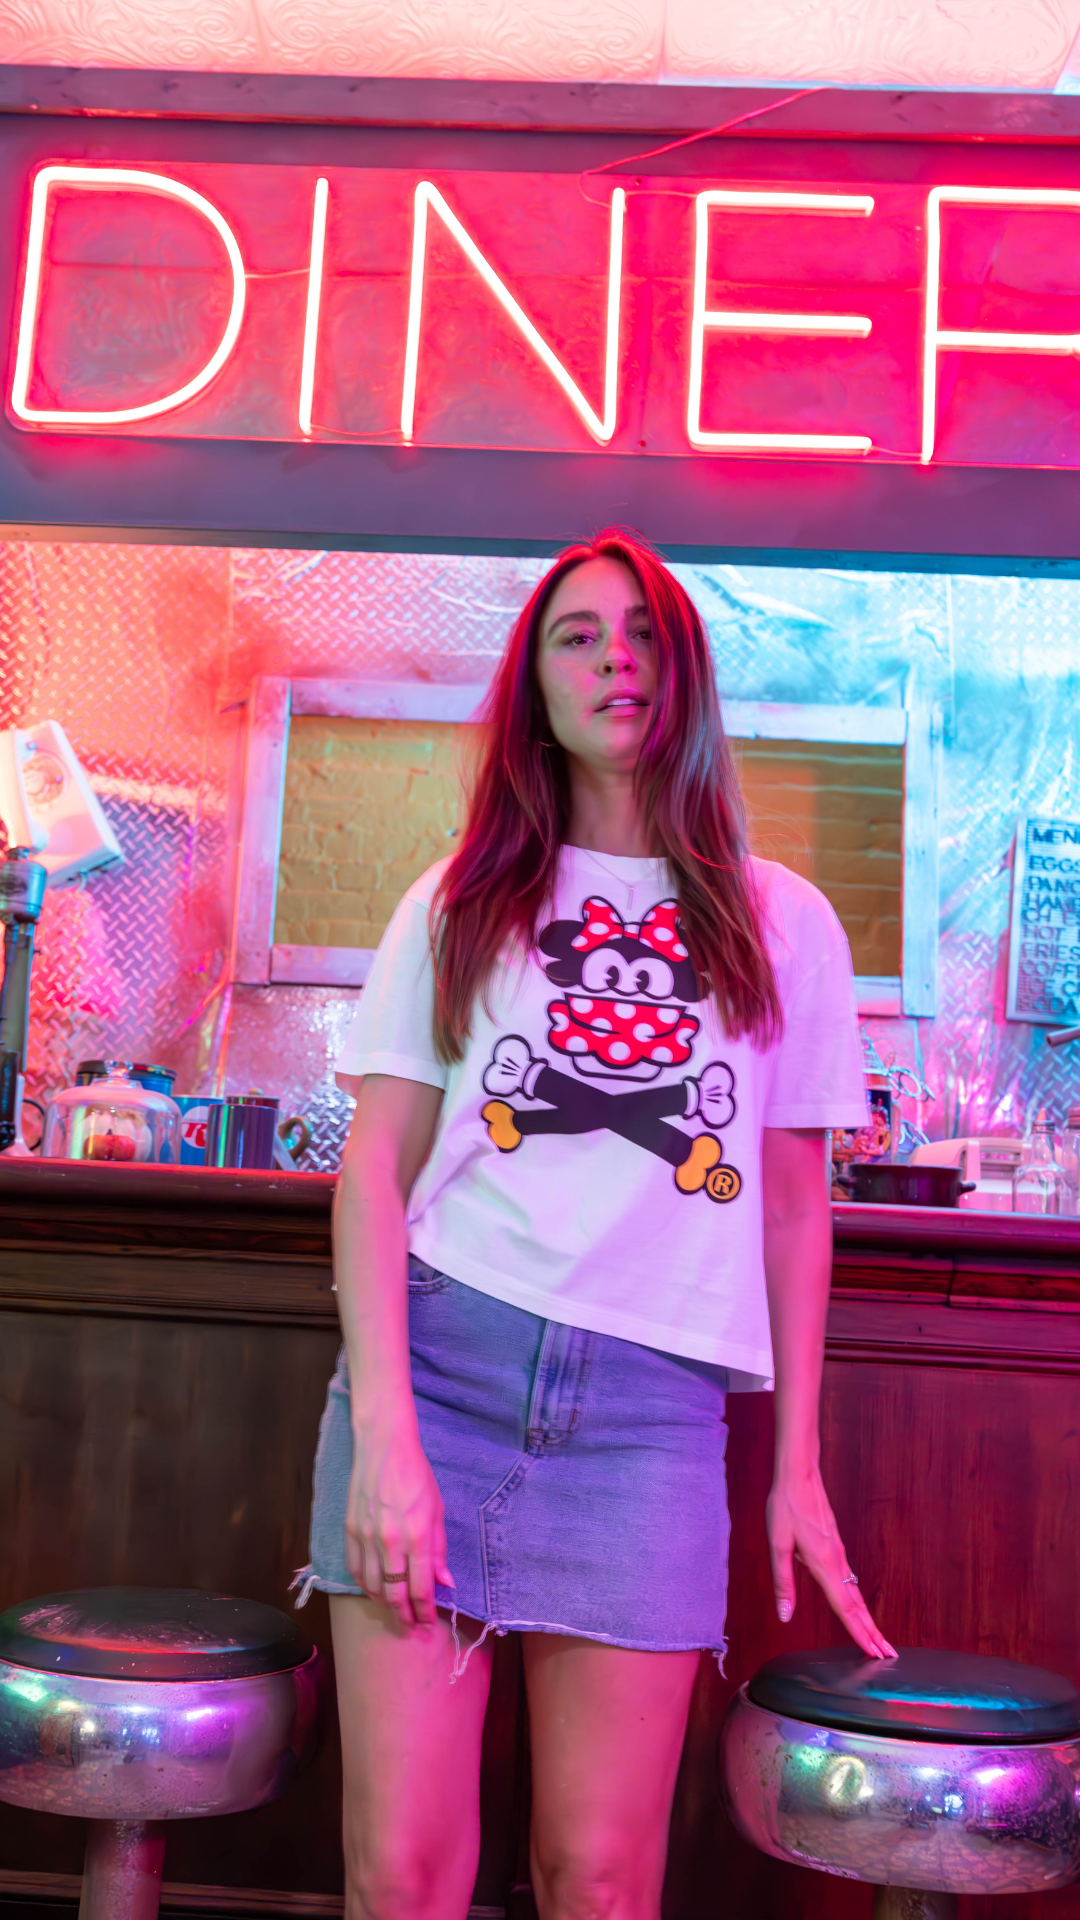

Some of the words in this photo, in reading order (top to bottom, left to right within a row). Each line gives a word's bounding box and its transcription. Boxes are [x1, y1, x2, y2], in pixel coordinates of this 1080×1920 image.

[11, 165, 1080, 463] DINER
[1033, 827, 1080, 843] MEN
[1022, 924, 1066, 941] HOT
[1021, 942, 1080, 961] FRIES
[1018, 960, 1080, 978] COFF
[1061, 981, 1080, 997] C
[1017, 995, 1077, 1015] SODA
